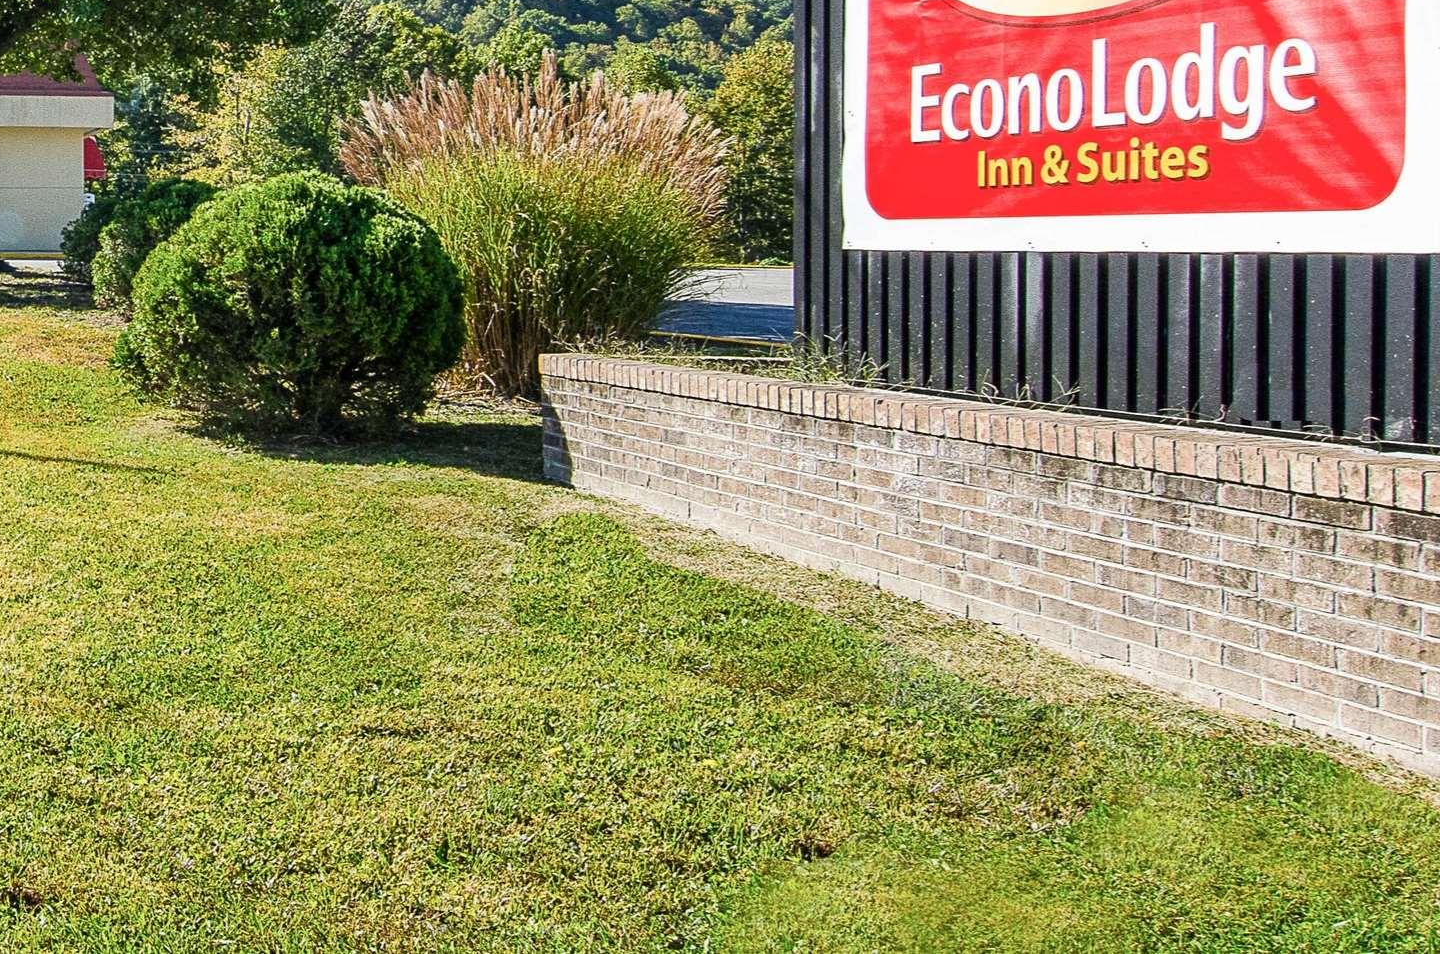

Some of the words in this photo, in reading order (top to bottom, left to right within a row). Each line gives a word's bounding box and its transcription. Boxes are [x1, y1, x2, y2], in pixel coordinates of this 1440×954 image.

[977, 150, 1033, 188] Inn
[1040, 144, 1070, 185] &
[1076, 137, 1210, 183] Suites
